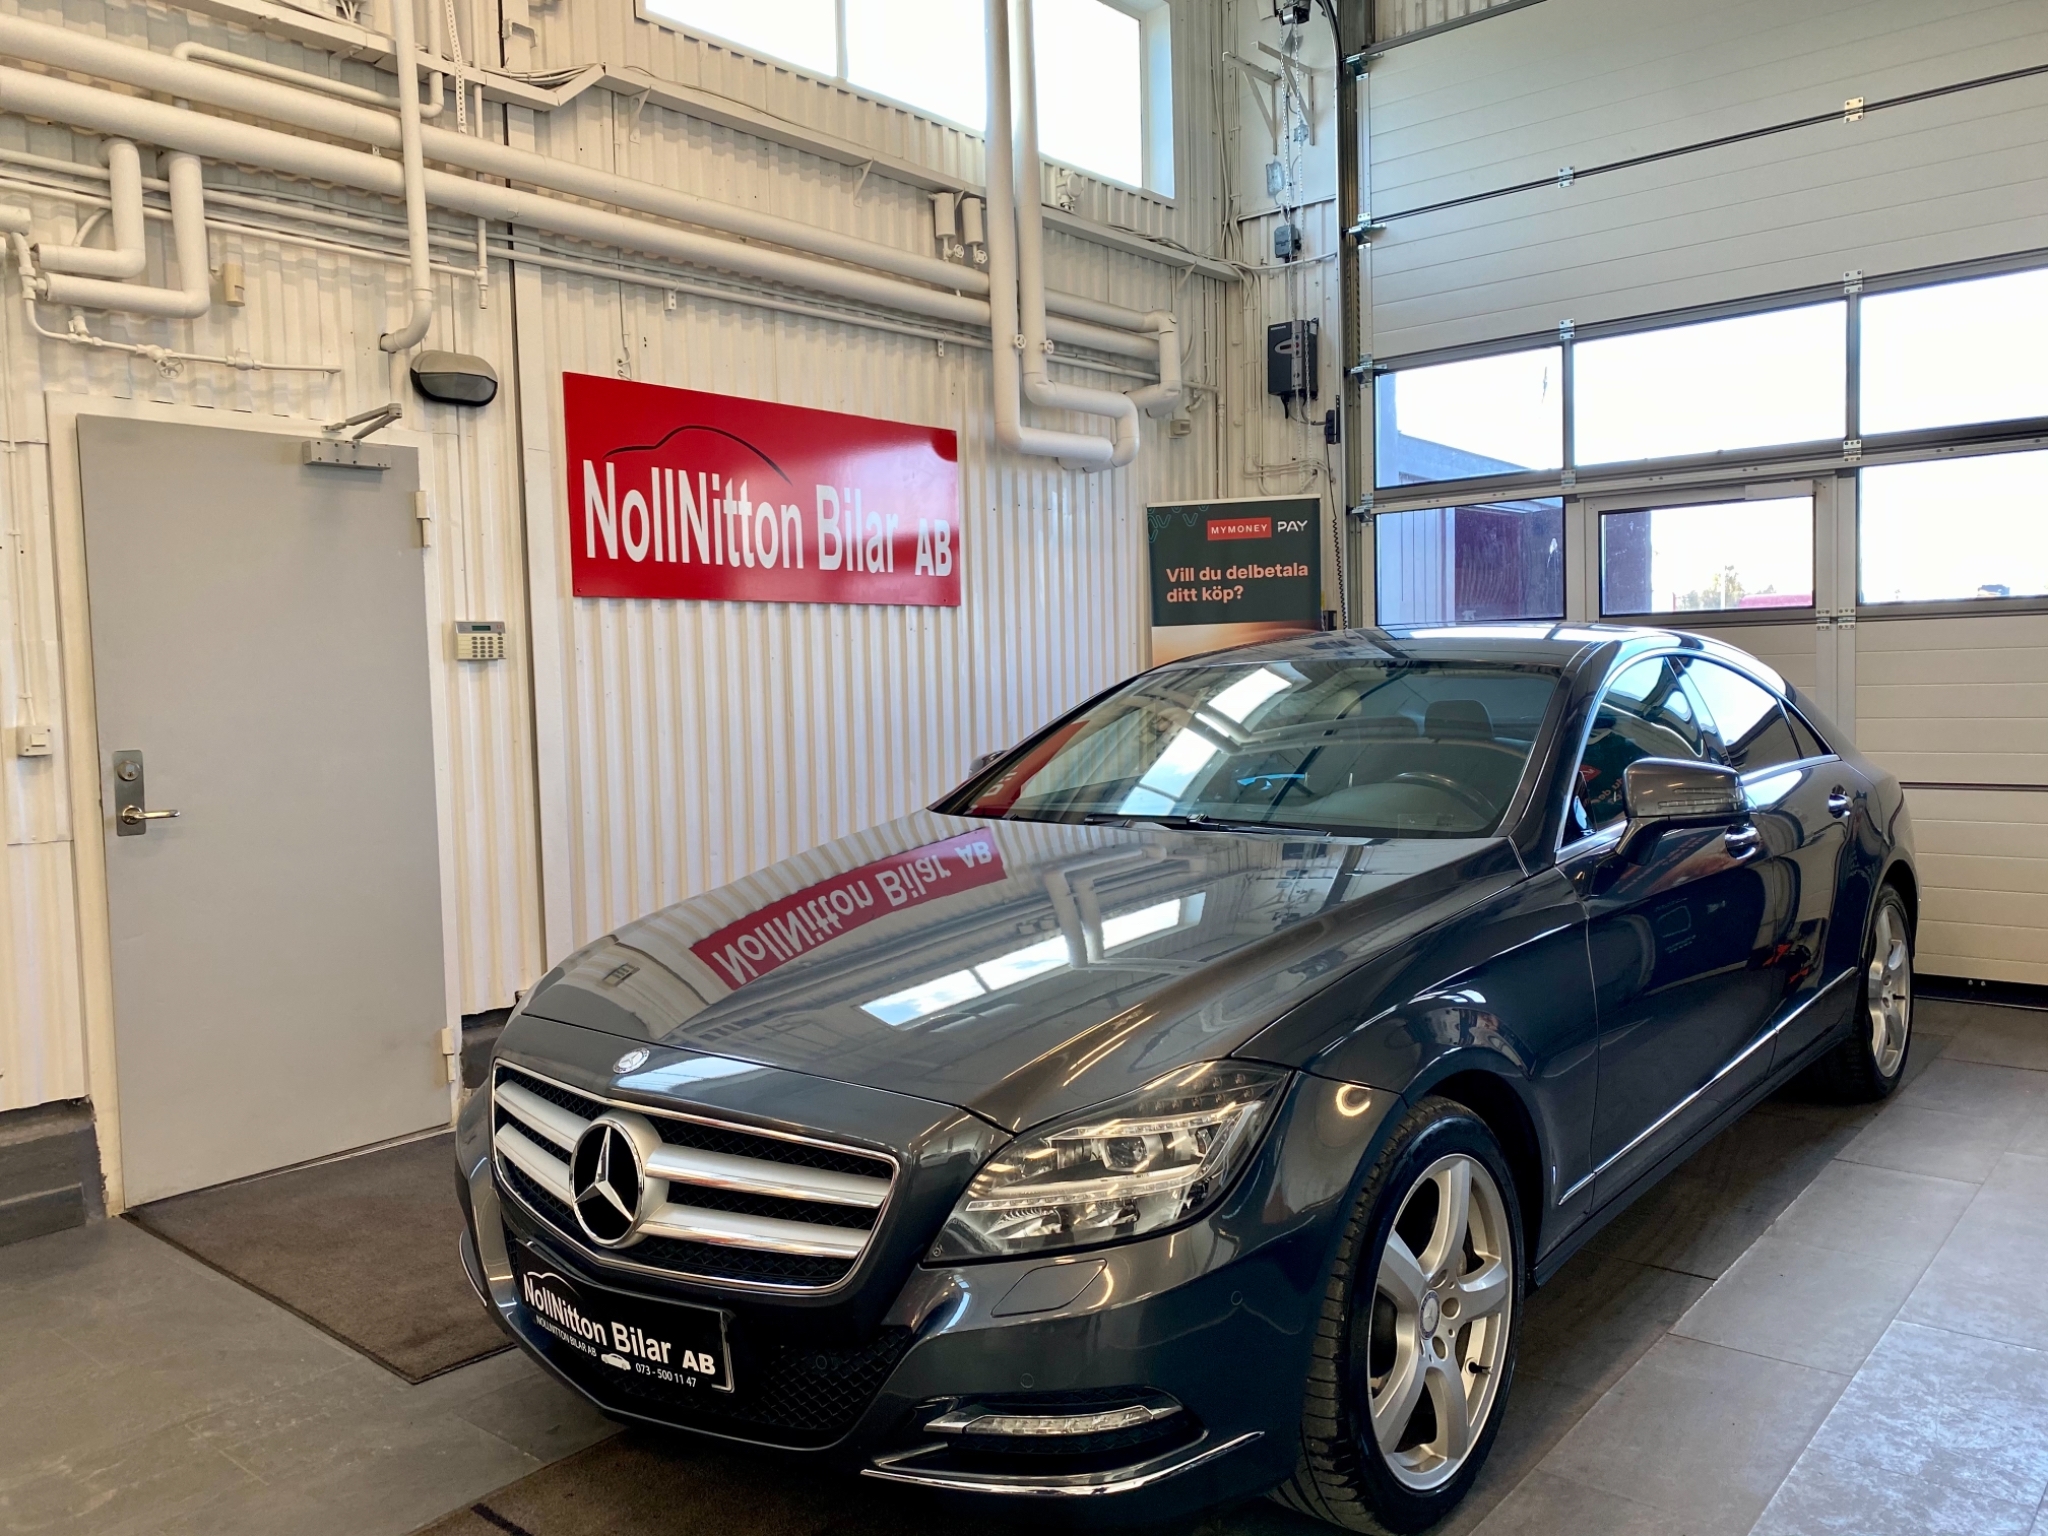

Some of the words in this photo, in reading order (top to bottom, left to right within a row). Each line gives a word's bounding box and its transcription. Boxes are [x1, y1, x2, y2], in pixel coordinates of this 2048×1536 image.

[583, 459, 803, 569] NollNitton
[816, 484, 897, 574] Bilar
[915, 518, 952, 576] AB
[1211, 523, 1268, 535] MYMONEY
[1277, 520, 1308, 533] PAY
[1166, 567, 1195, 582] Vill
[1199, 566, 1222, 581] du
[1226, 562, 1309, 580] delbetala
[1166, 587, 1198, 603] ditt
[1202, 585, 1244, 603] köp?
[523, 1273, 607, 1347] NollNitton
[611, 1321, 671, 1364] Bilar
[682, 1350, 716, 1375] AB
[635, 1362, 651, 1376] 073
[657, 1368, 673, 1381] 500
[674, 1373, 684, 1385] 11
[686, 1376, 697, 1388] 47
